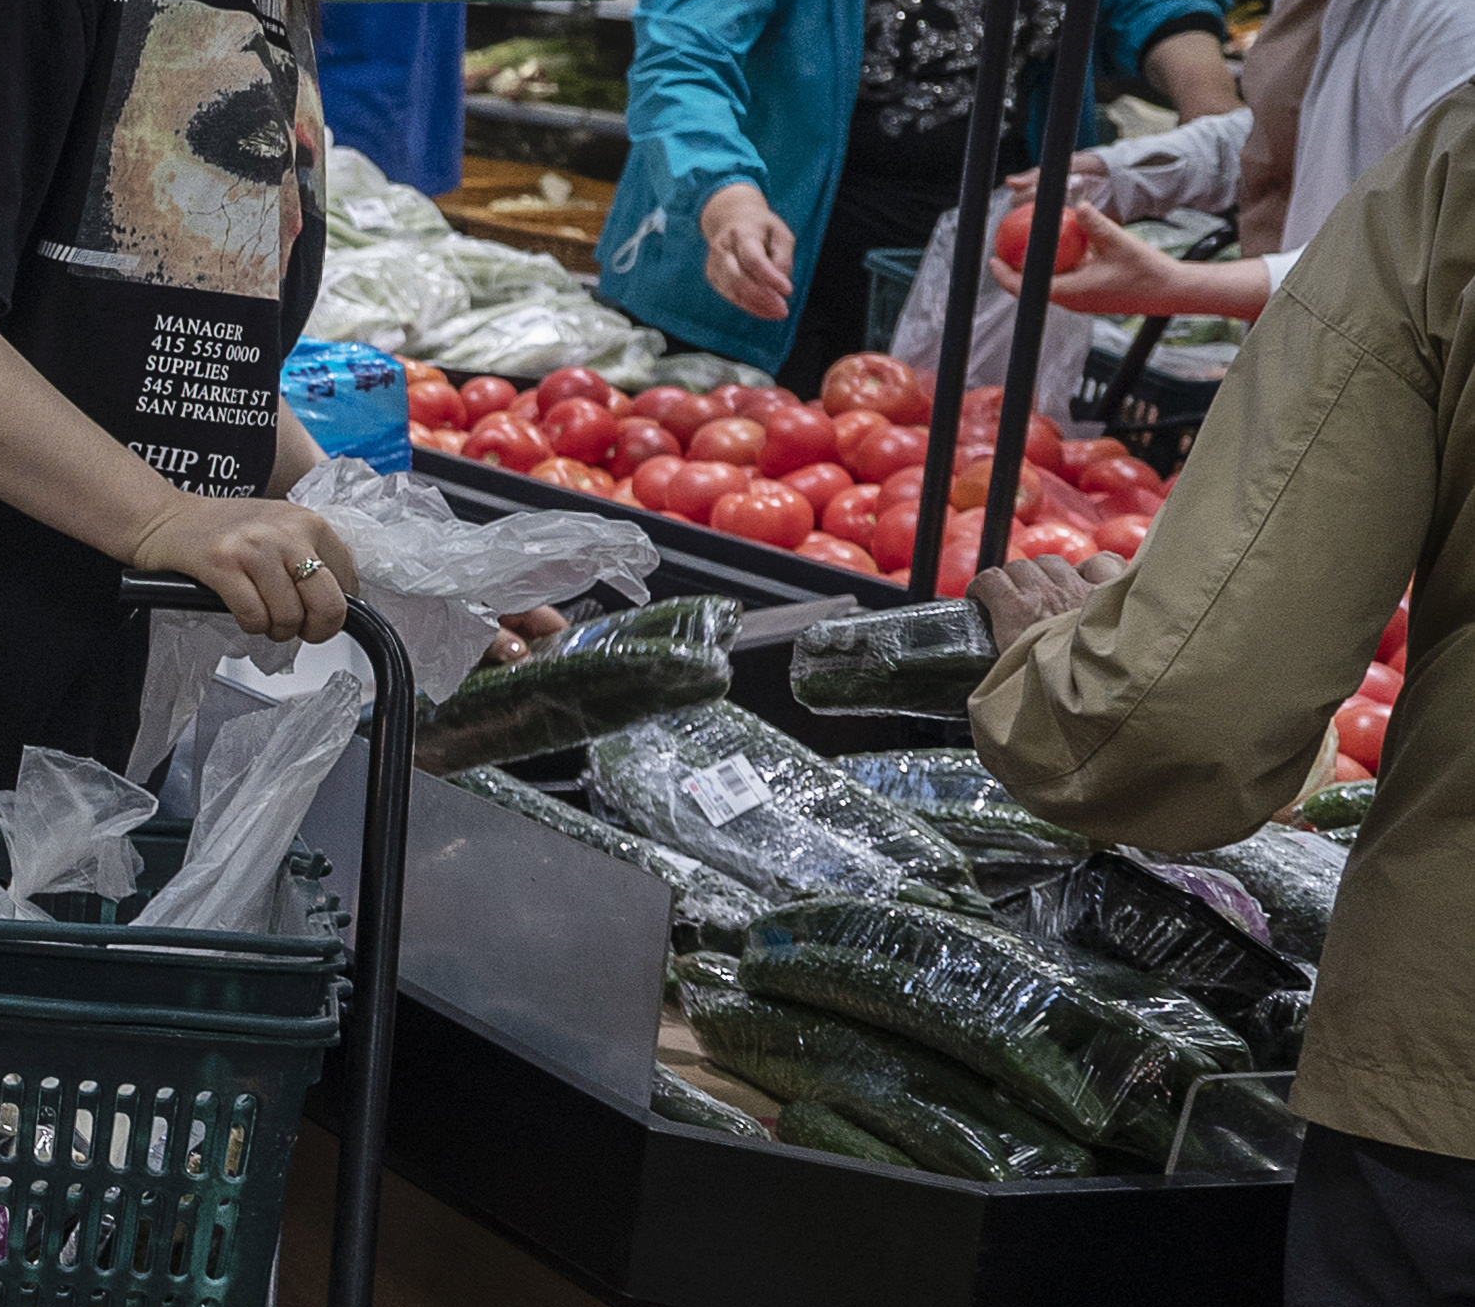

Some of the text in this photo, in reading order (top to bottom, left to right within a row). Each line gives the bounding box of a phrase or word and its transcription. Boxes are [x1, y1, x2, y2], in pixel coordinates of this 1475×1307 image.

[154, 314, 244, 342] MANAGER
[151, 335, 261, 364] 415 555 0000
[145, 354, 229, 381] SUPPLIES
[142, 376, 271, 407] 545 MARKET ST
[136, 396, 177, 416] SAN
[207, 454, 241, 481] TO:
